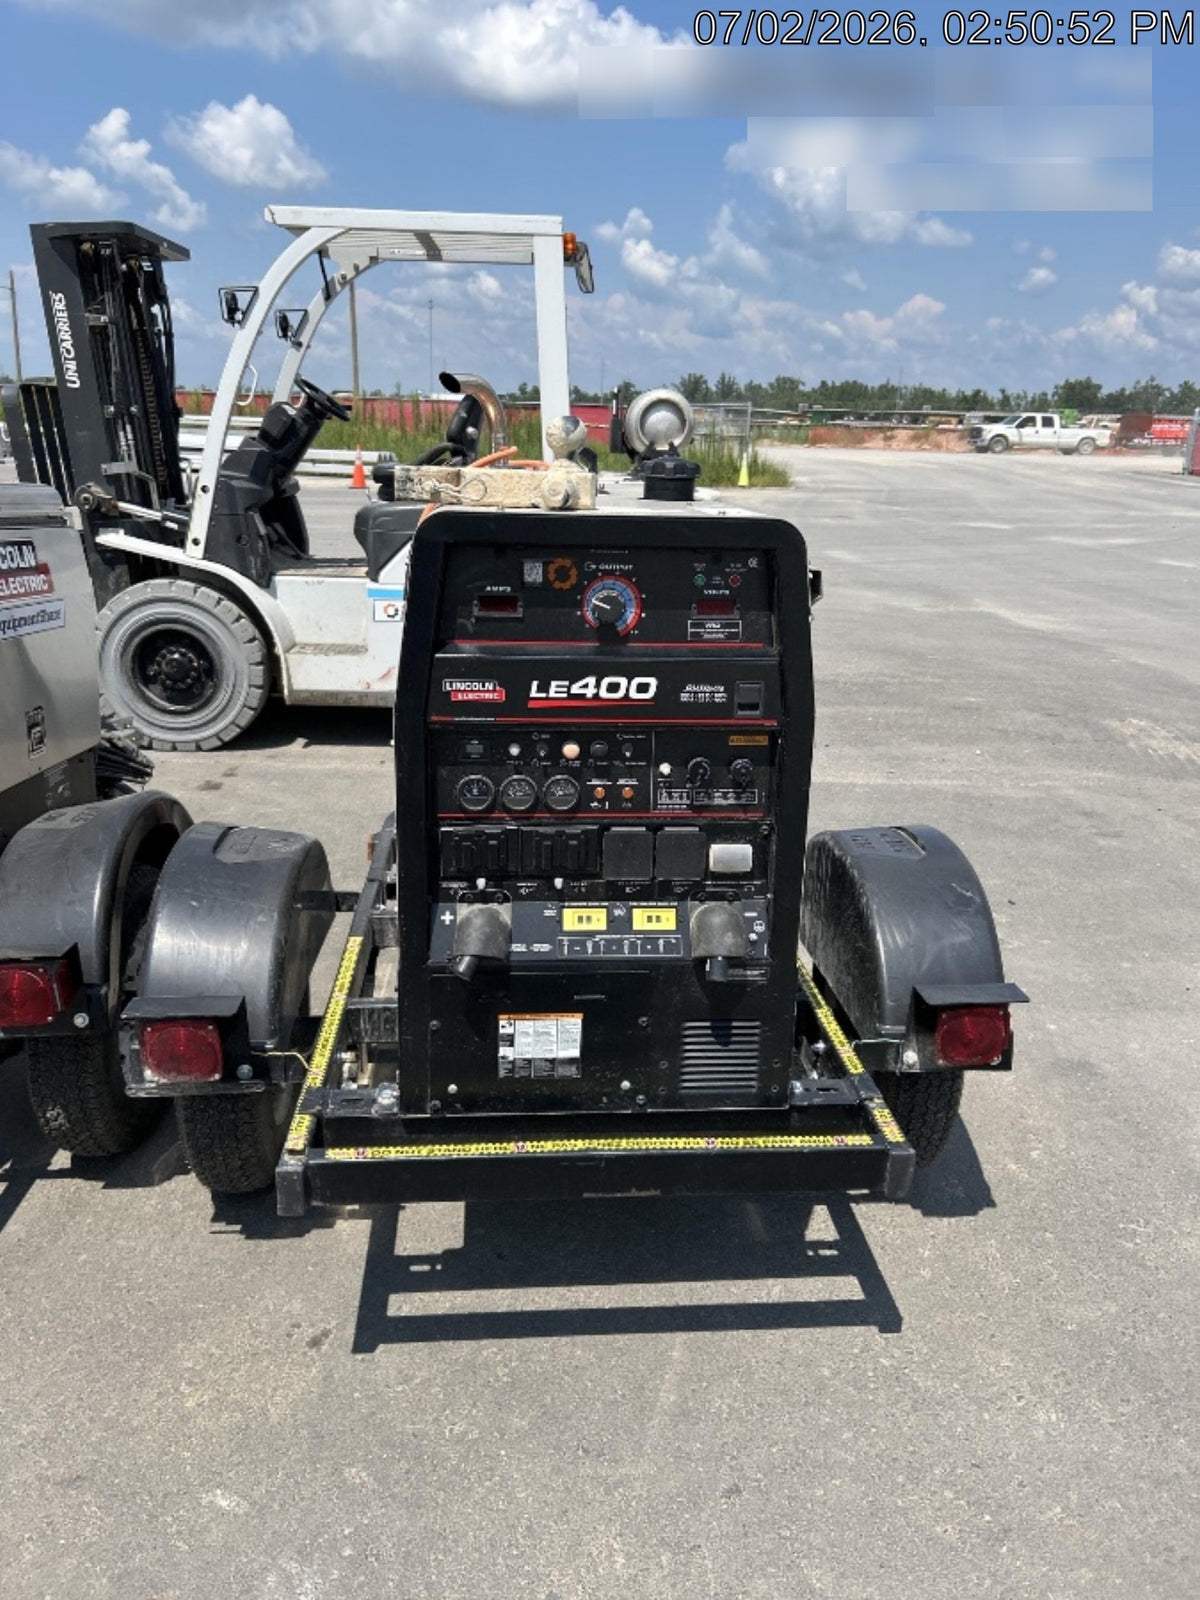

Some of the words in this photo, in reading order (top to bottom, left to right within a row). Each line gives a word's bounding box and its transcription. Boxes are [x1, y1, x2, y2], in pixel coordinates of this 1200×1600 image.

[49, 289, 80, 389] UNICARRIERS
[445, 682, 494, 691] LINCOLN
[529, 676, 658, 699] LE400
[457, 691, 501, 700] ELECTRIC
